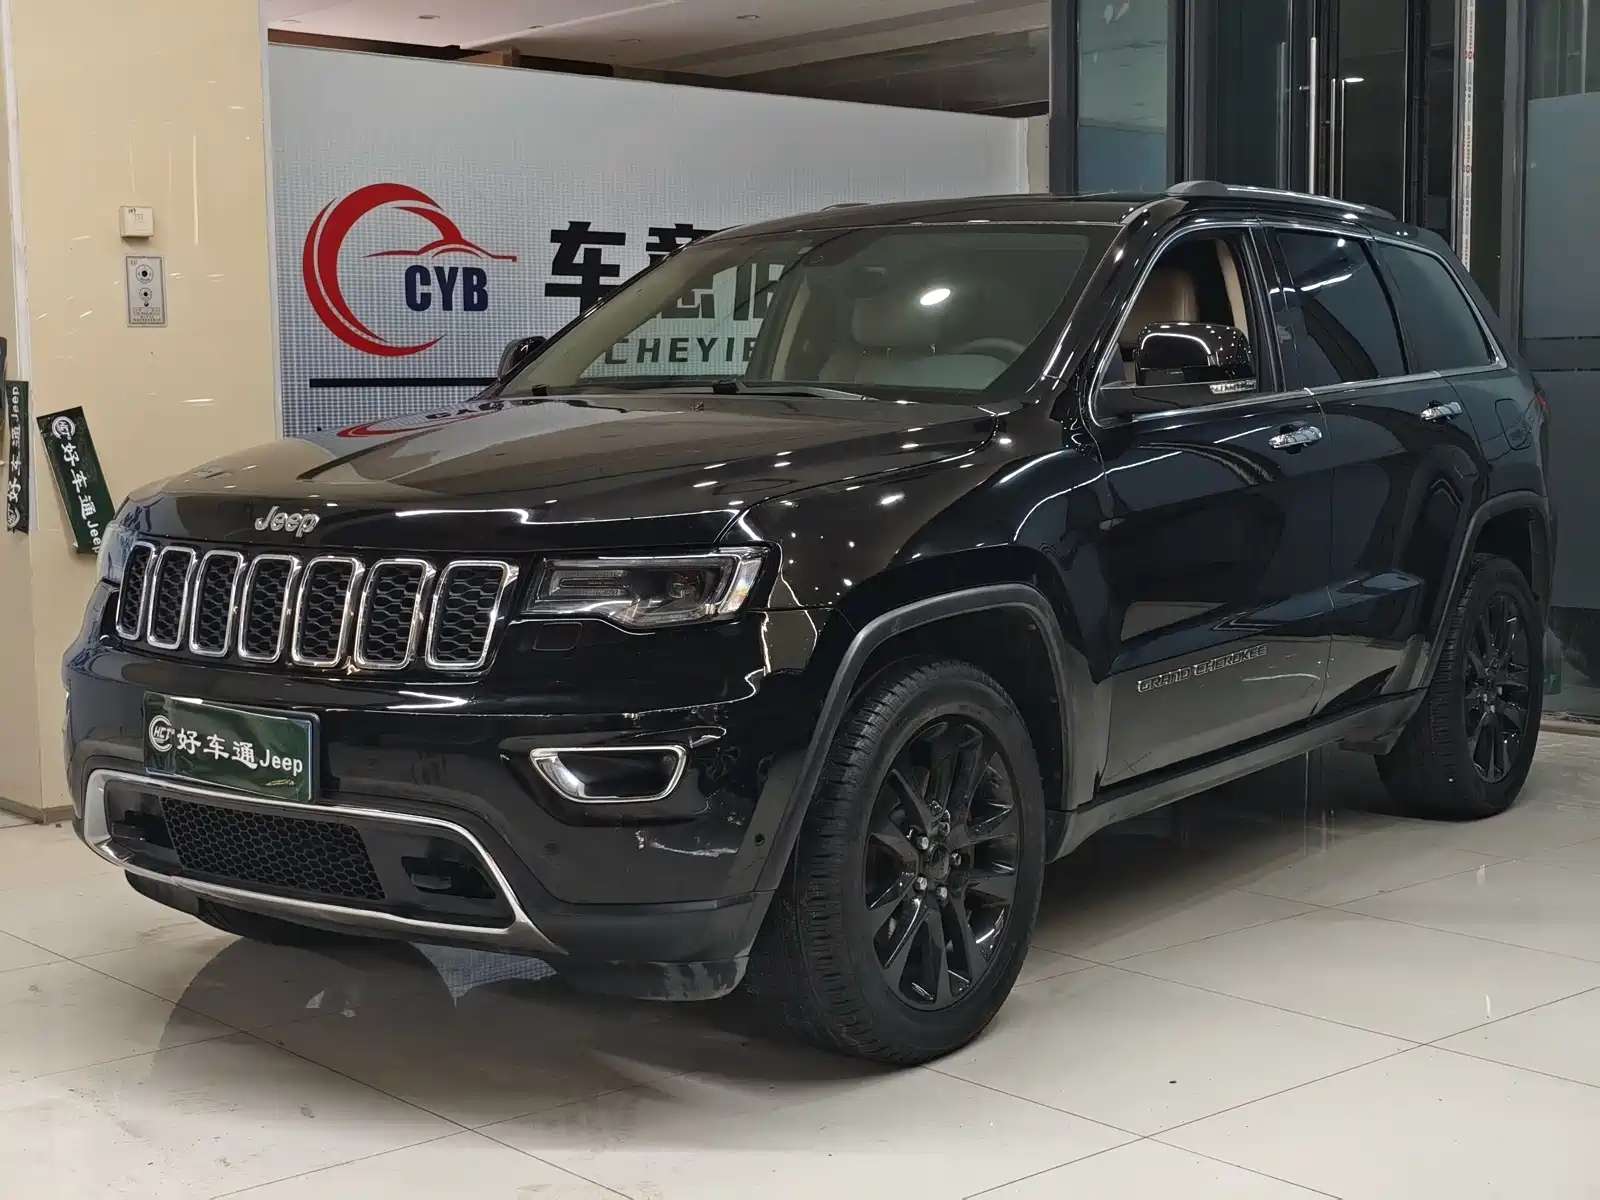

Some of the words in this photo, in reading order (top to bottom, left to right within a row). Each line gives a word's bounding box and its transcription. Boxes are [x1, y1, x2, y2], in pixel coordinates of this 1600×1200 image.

[404, 264, 488, 312] CYB
[254, 505, 320, 537] Jeep
[1137, 666, 1191, 693] GRAND
[1193, 643, 1267, 676] CHEROKEE
